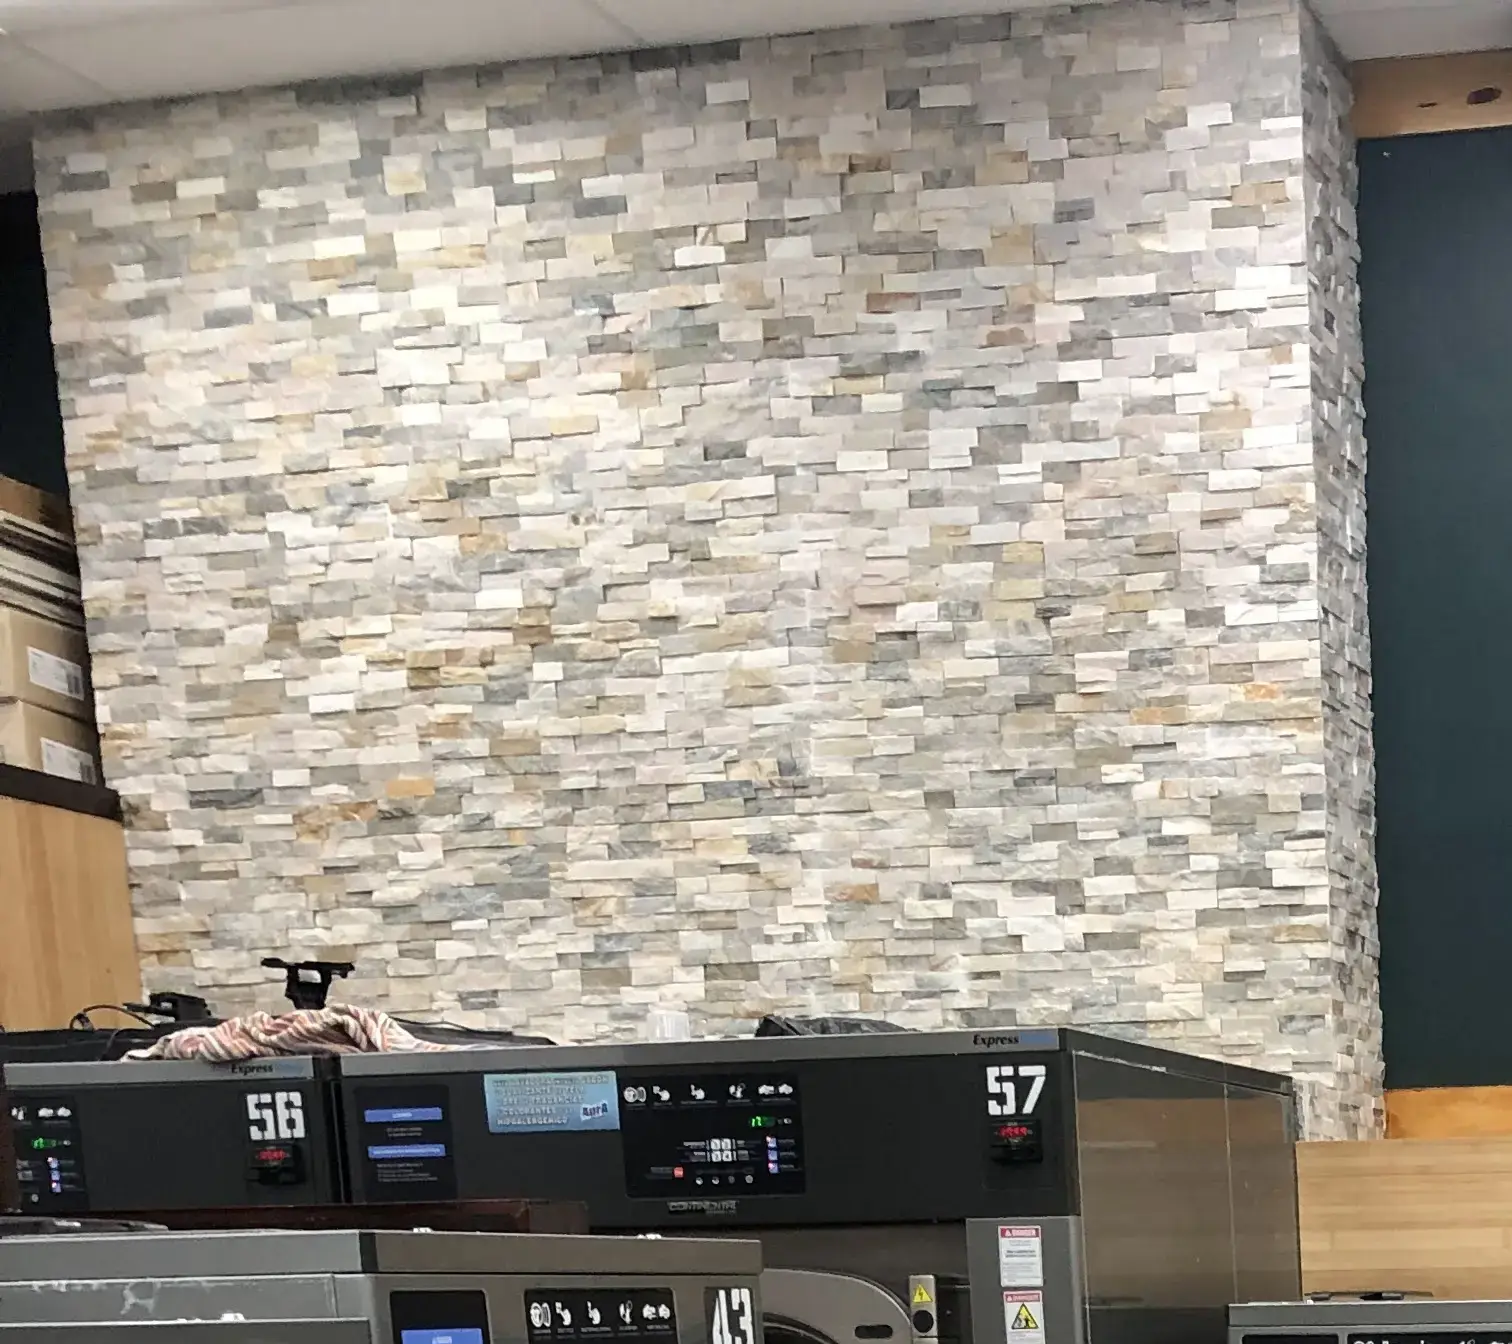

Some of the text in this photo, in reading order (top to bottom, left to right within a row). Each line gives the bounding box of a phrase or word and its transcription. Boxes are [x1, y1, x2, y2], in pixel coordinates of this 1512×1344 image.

[973, 1034, 1019, 1048] Express
[231, 1064, 274, 1076] Express
[986, 1065, 1046, 1115] 57
[247, 1091, 305, 1140] 56
